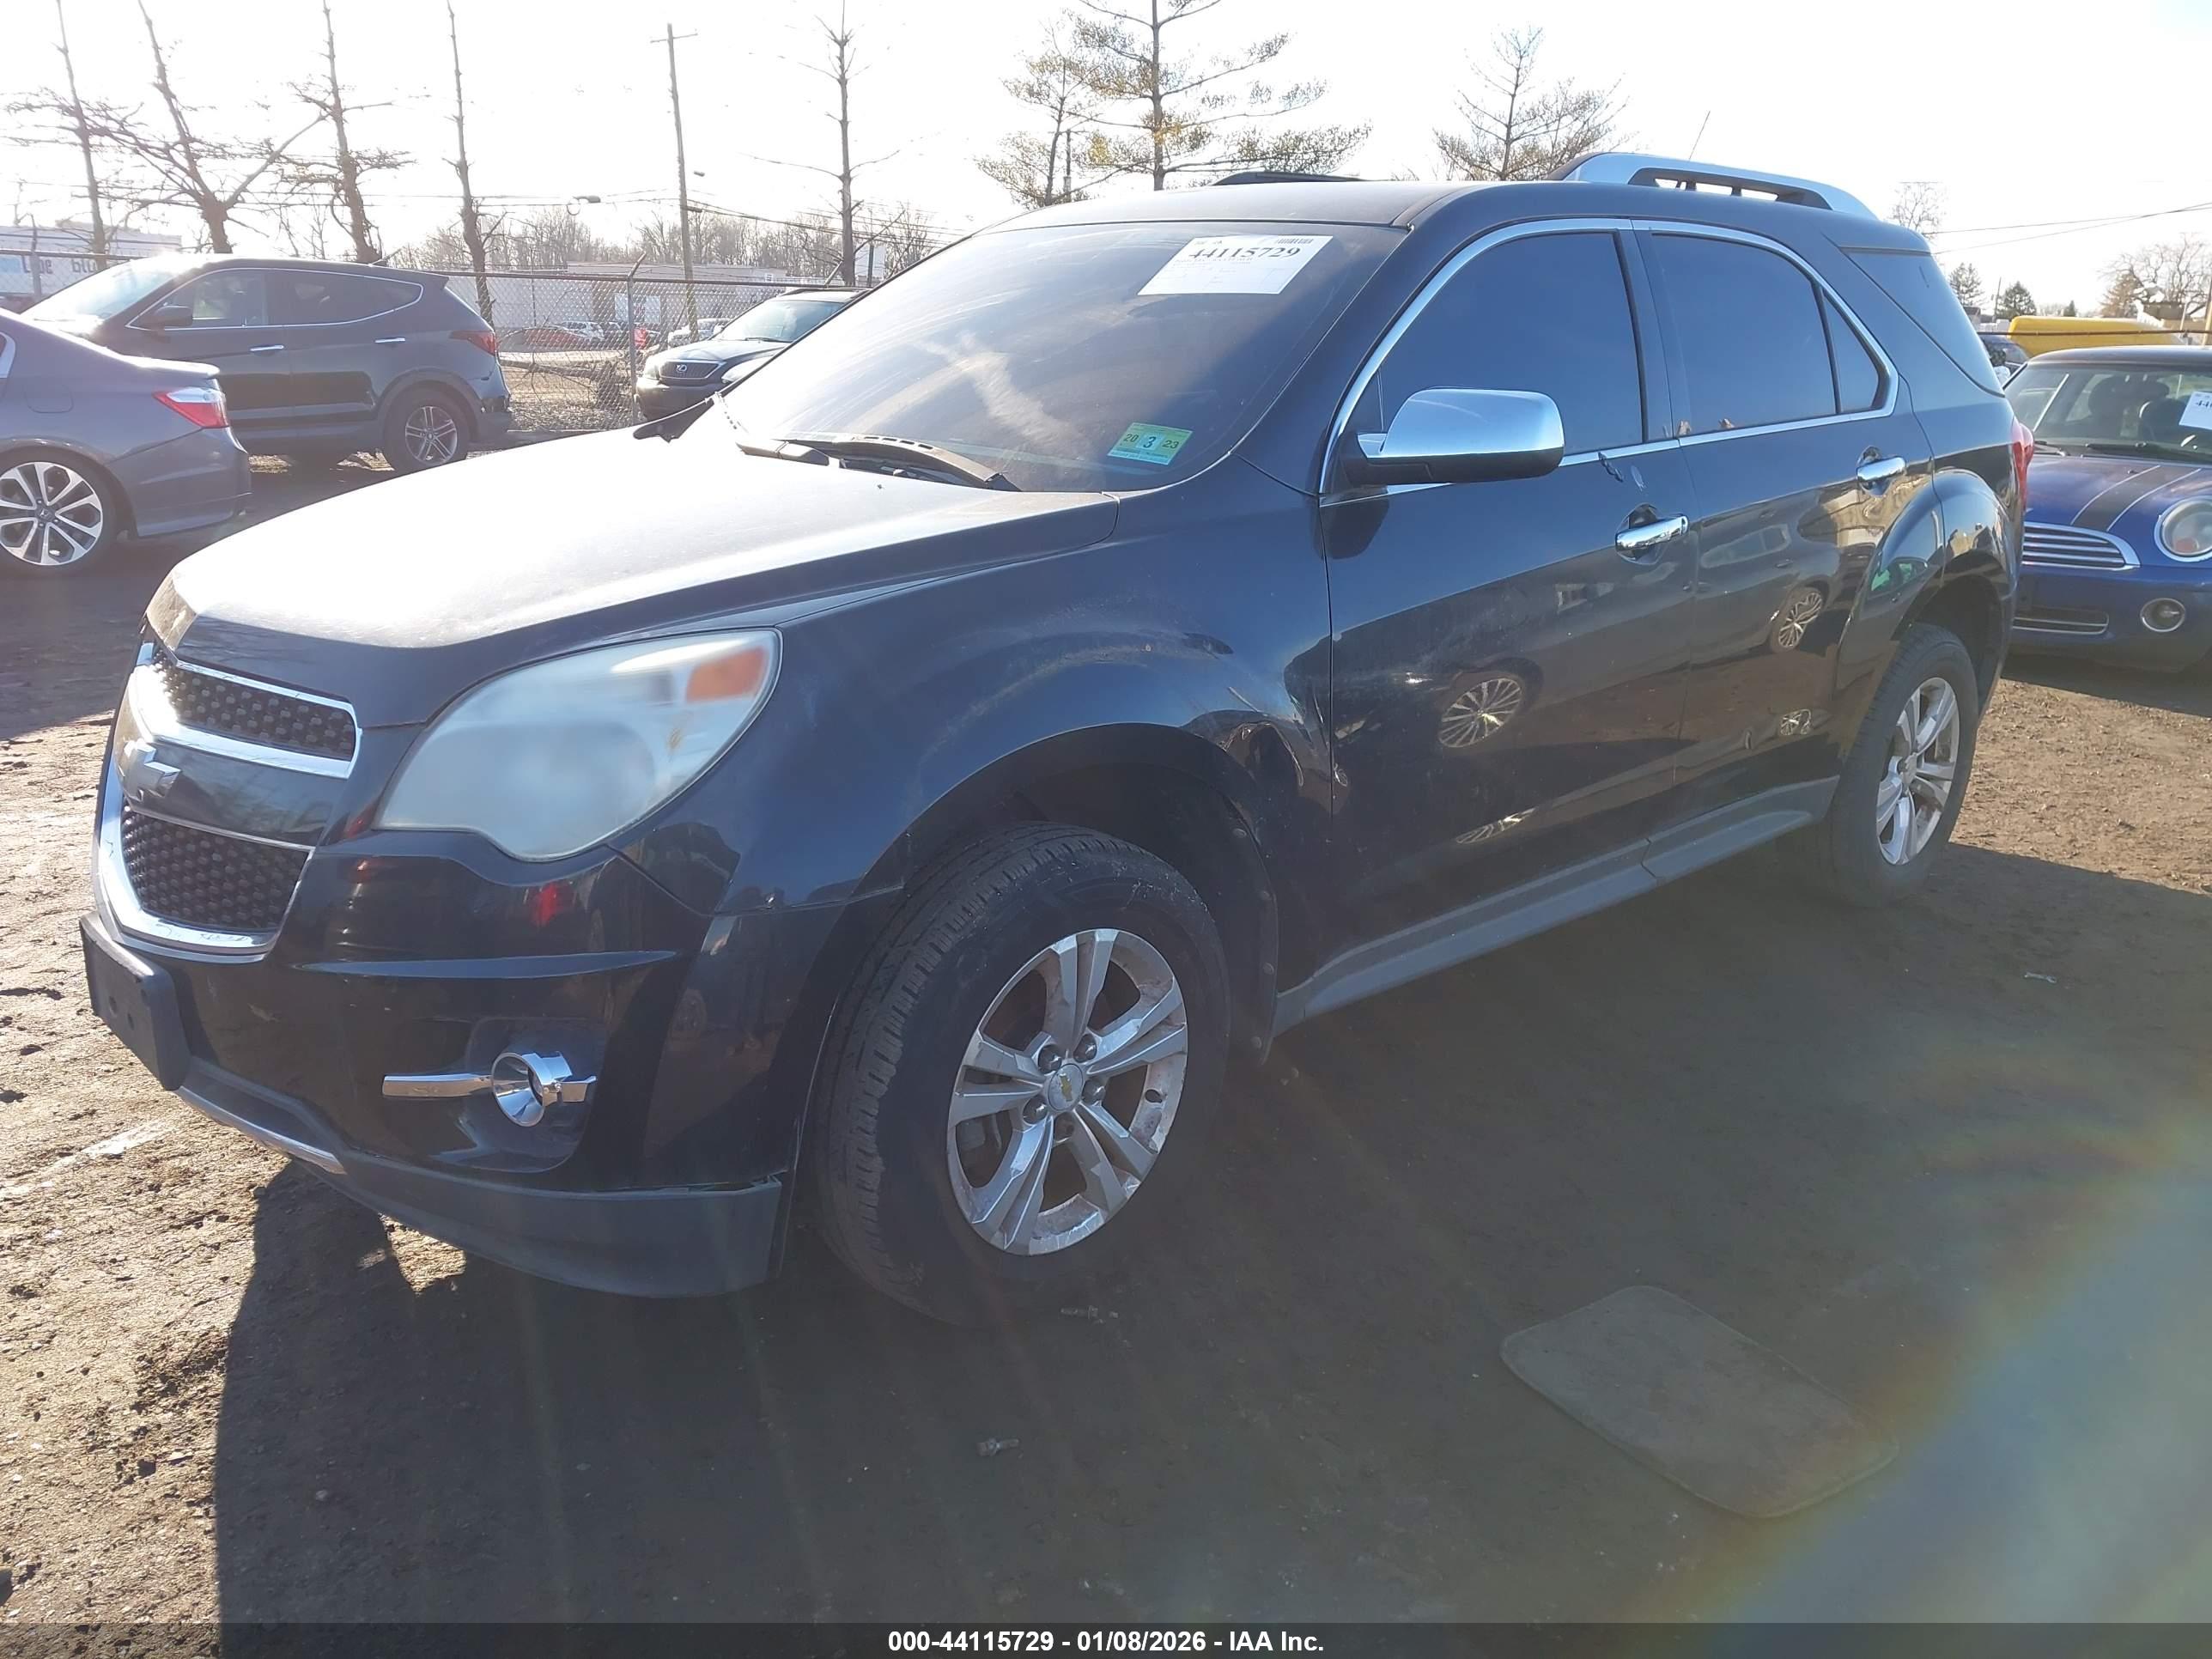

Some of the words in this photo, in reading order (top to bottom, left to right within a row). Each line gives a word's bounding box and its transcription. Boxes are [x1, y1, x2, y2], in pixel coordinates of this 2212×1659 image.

[1188, 246, 1301, 258] 44115729
[1123, 434, 1139, 442] 20
[1143, 436, 1156, 448] 3
[1162, 440, 1179, 449] 23
